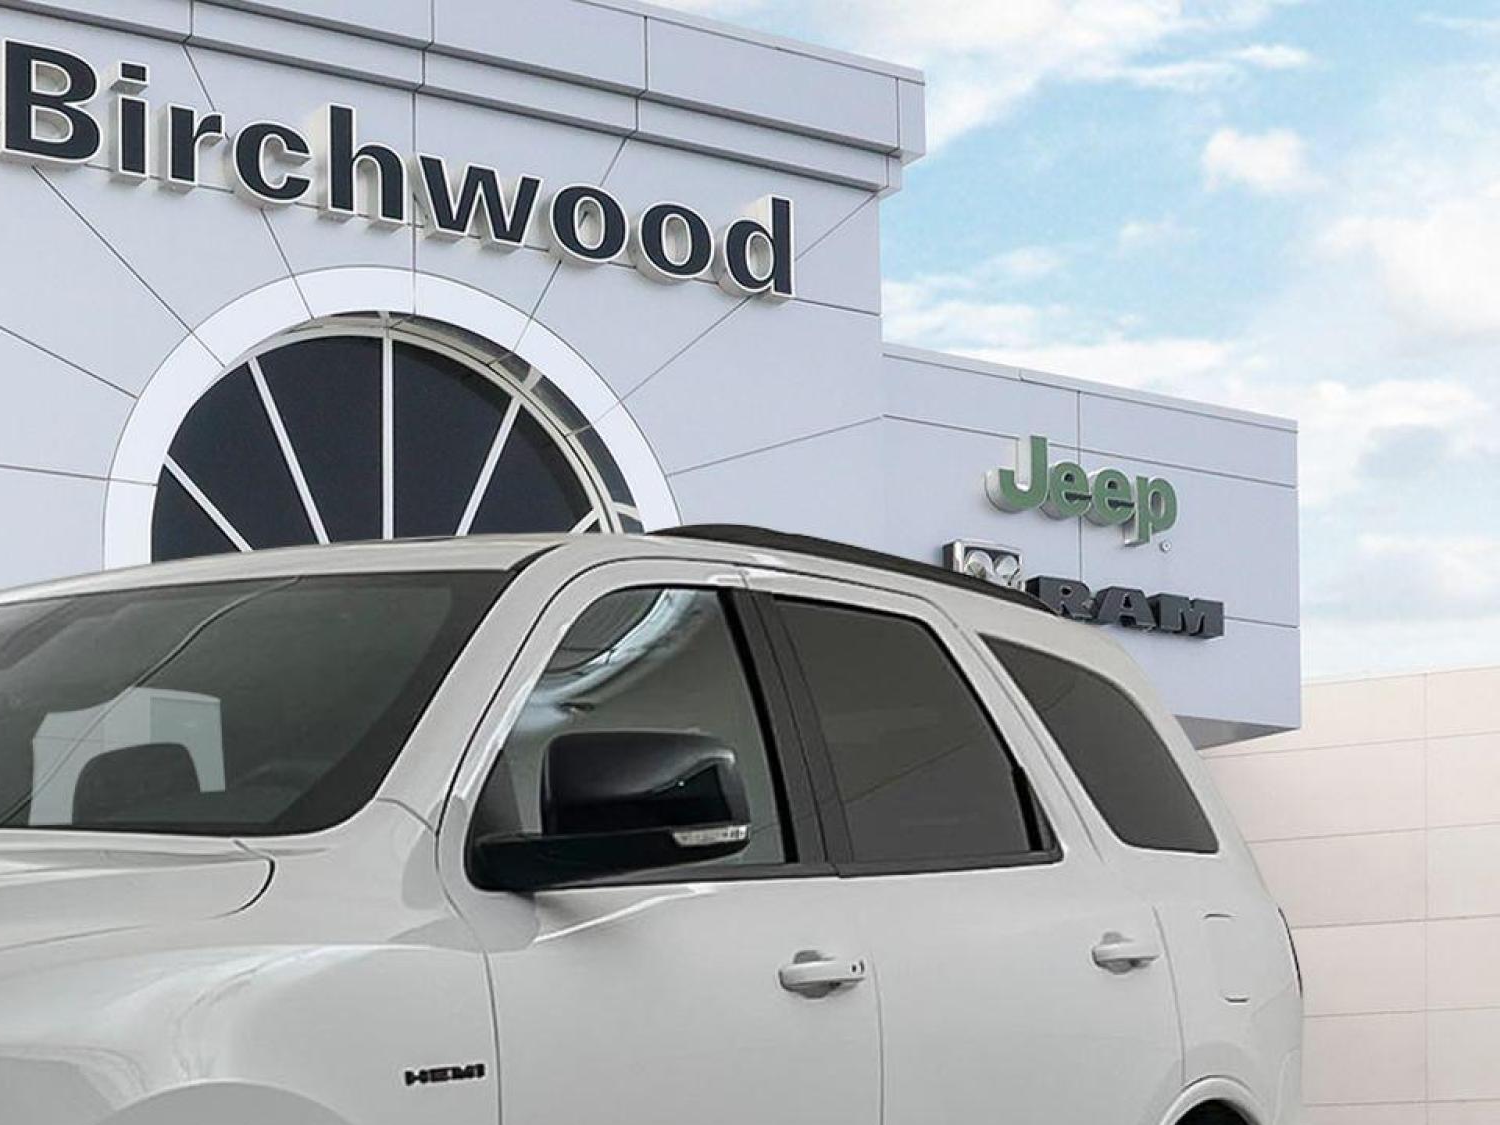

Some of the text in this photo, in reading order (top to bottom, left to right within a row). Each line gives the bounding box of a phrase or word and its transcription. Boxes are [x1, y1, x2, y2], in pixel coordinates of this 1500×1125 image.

[987, 434, 1179, 547] Jeep
[1028, 575, 1225, 639] RAM
[405, 1063, 486, 1086] HEMI
